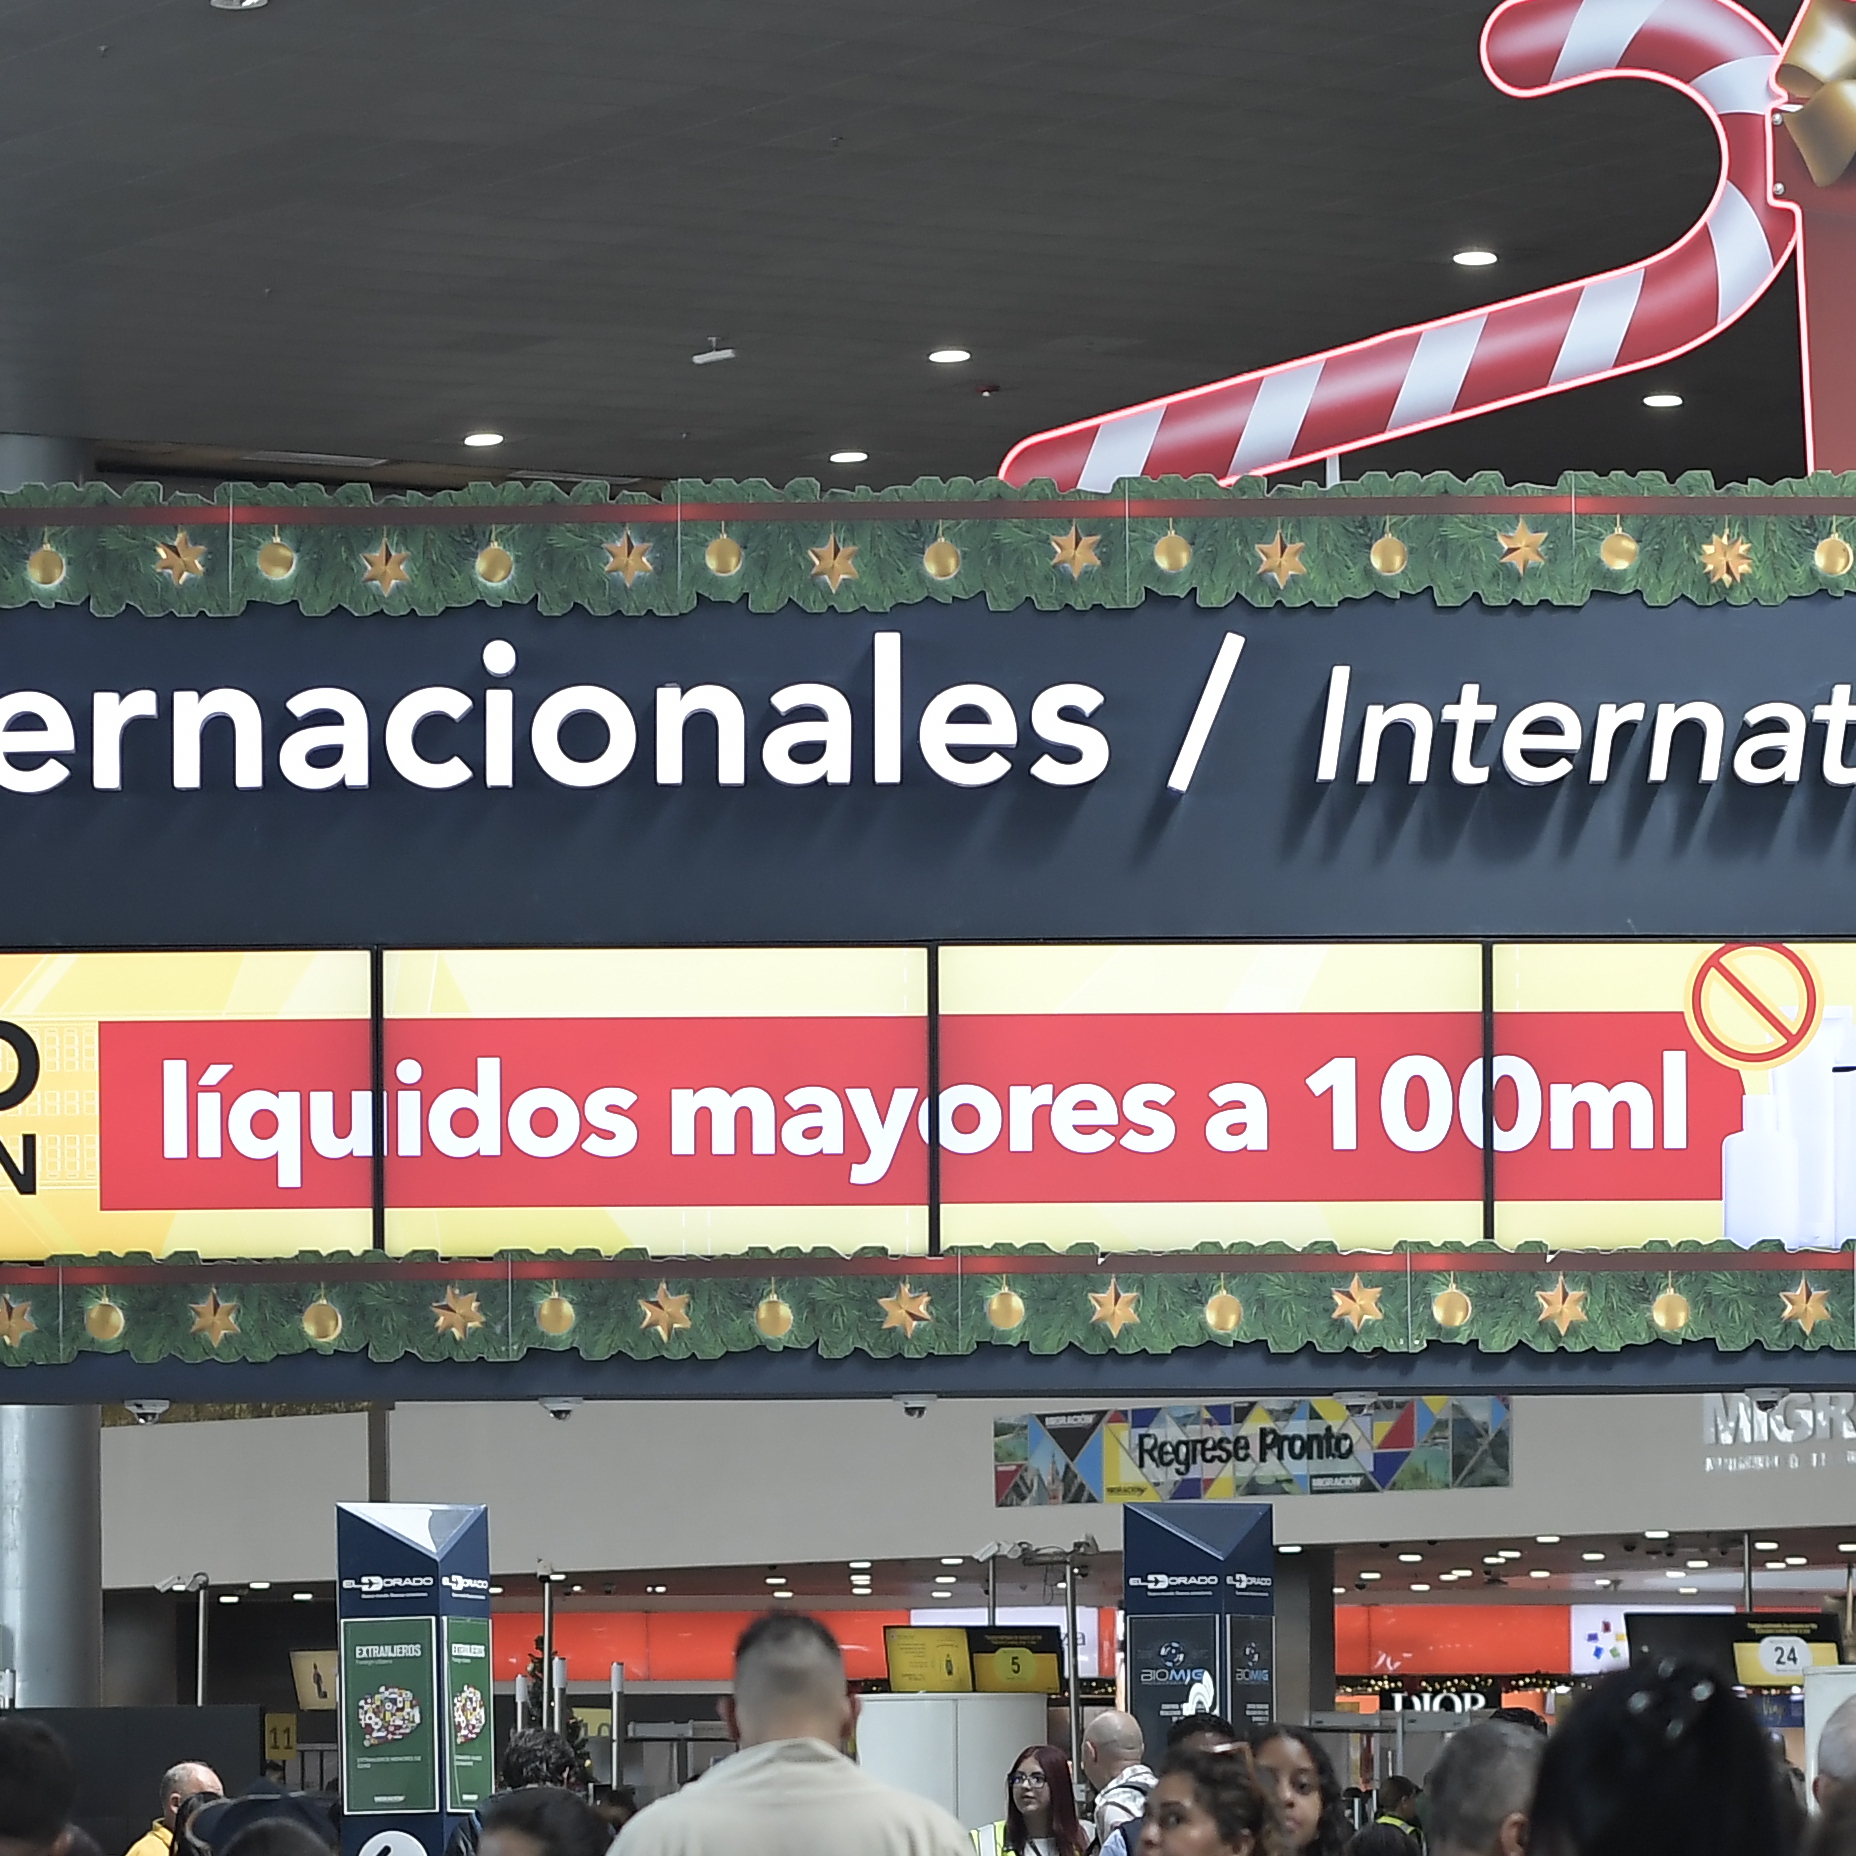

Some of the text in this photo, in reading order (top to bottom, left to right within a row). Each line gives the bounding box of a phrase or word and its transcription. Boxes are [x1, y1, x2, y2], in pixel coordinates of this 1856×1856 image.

[1166, 632, 1246, 796] /
[161, 1049, 1689, 1190] líquidos mayores a 100ml
[1138, 1424, 1354, 1476] Regrese Pronto
[355, 1644, 422, 1659] EXTRANJEROS
[1774, 1646, 1798, 1666] 24
[1011, 1656, 1021, 1674] 5
[269, 1727, 294, 1750] 11
